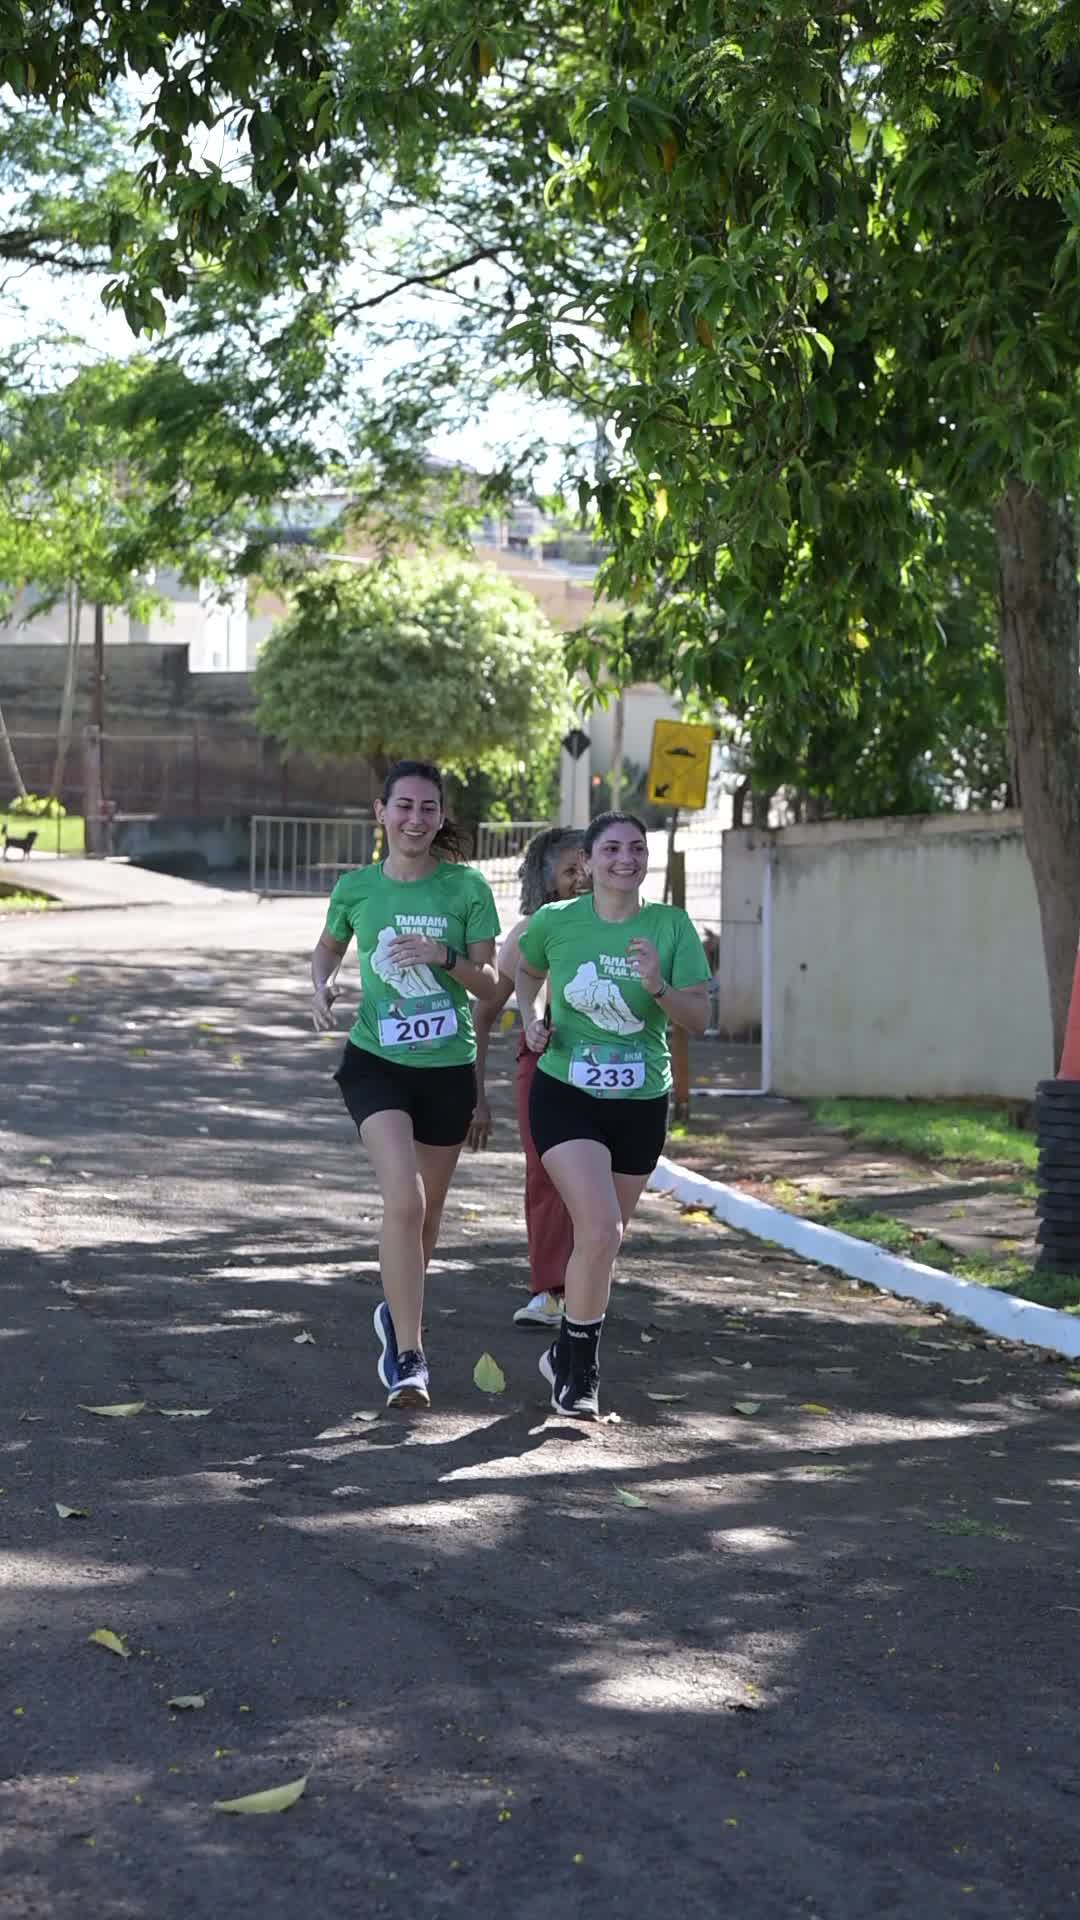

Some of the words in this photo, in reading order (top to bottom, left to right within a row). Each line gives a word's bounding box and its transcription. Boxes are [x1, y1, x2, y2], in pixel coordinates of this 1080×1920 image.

[604, 965, 629, 977] TRAIL
[395, 1016, 446, 1042] 207
[585, 1068, 635, 1087] 233
